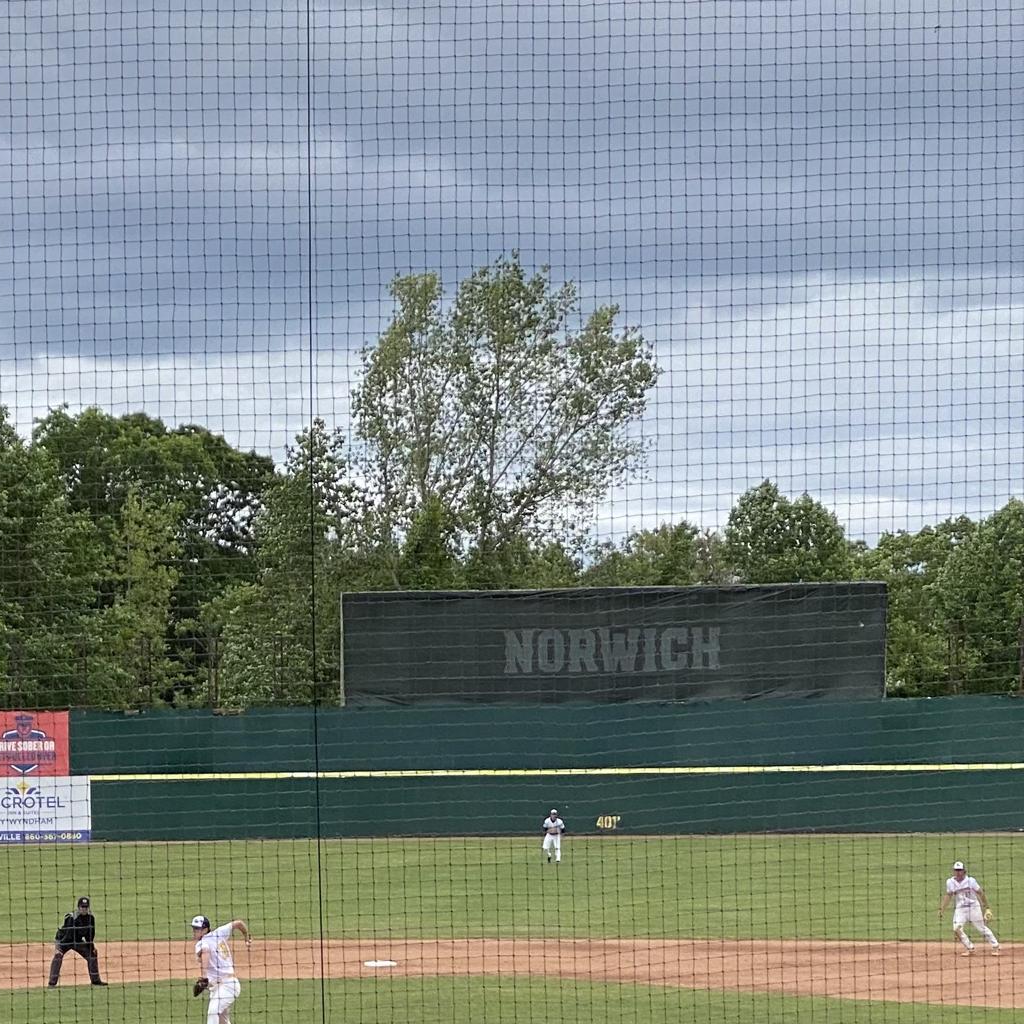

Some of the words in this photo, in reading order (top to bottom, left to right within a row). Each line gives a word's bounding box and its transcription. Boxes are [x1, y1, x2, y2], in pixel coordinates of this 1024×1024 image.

[503, 627, 721, 673] NORWICH
[17, 740, 43, 751] SOBER
[43, 740, 55, 751] OR
[9, 817, 53, 825] WYNDHAM
